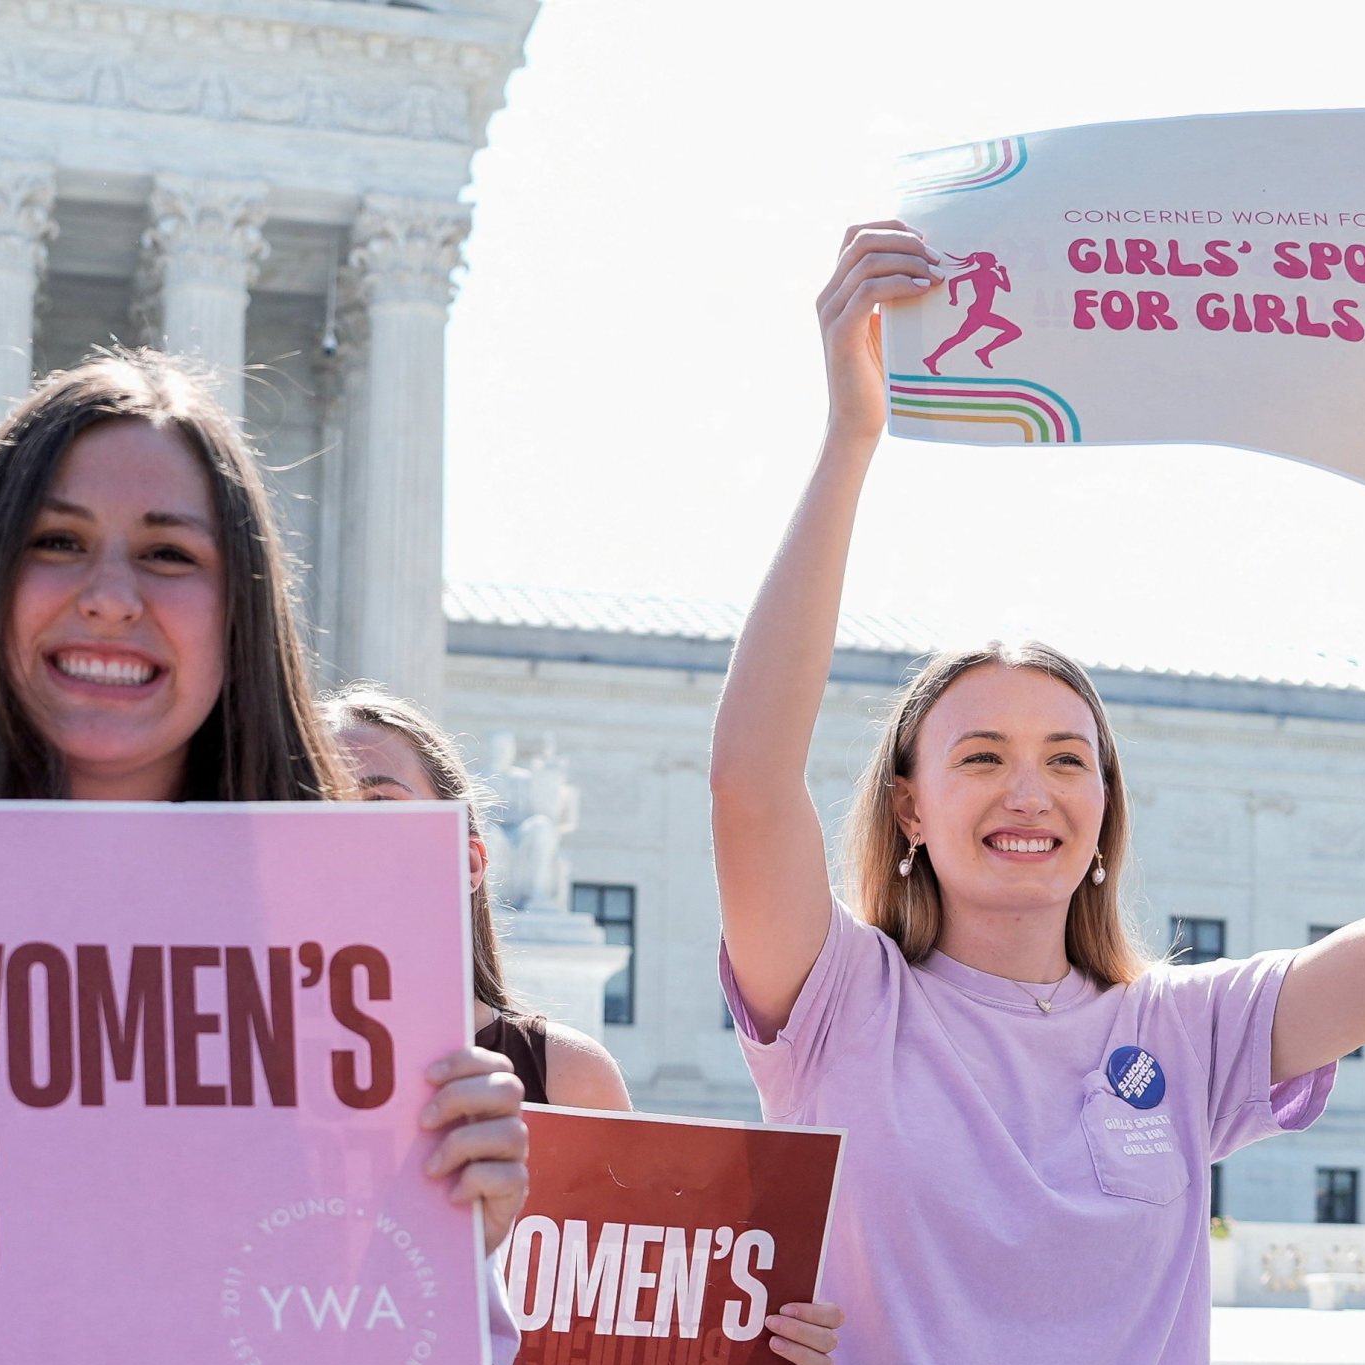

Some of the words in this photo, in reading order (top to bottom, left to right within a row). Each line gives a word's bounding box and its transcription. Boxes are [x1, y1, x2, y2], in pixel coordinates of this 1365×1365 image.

[1064, 209, 1223, 225] CONCERNED
[1232, 211, 1329, 227] WOMEN
[1067, 238, 1252, 277] GIRLS'
[1073, 289, 1178, 331] FOR
[1196, 292, 1365, 342] GIRLS
[1118, 1051, 1148, 1091] SPORTS
[1134, 1068, 1156, 1098] SAVE
[258, 1197, 348, 1235] YOUNG
[377, 1213, 439, 1299] WOMEN
[503, 1214, 776, 1342] OMEN’S
[259, 1283, 406, 1332] YWA
